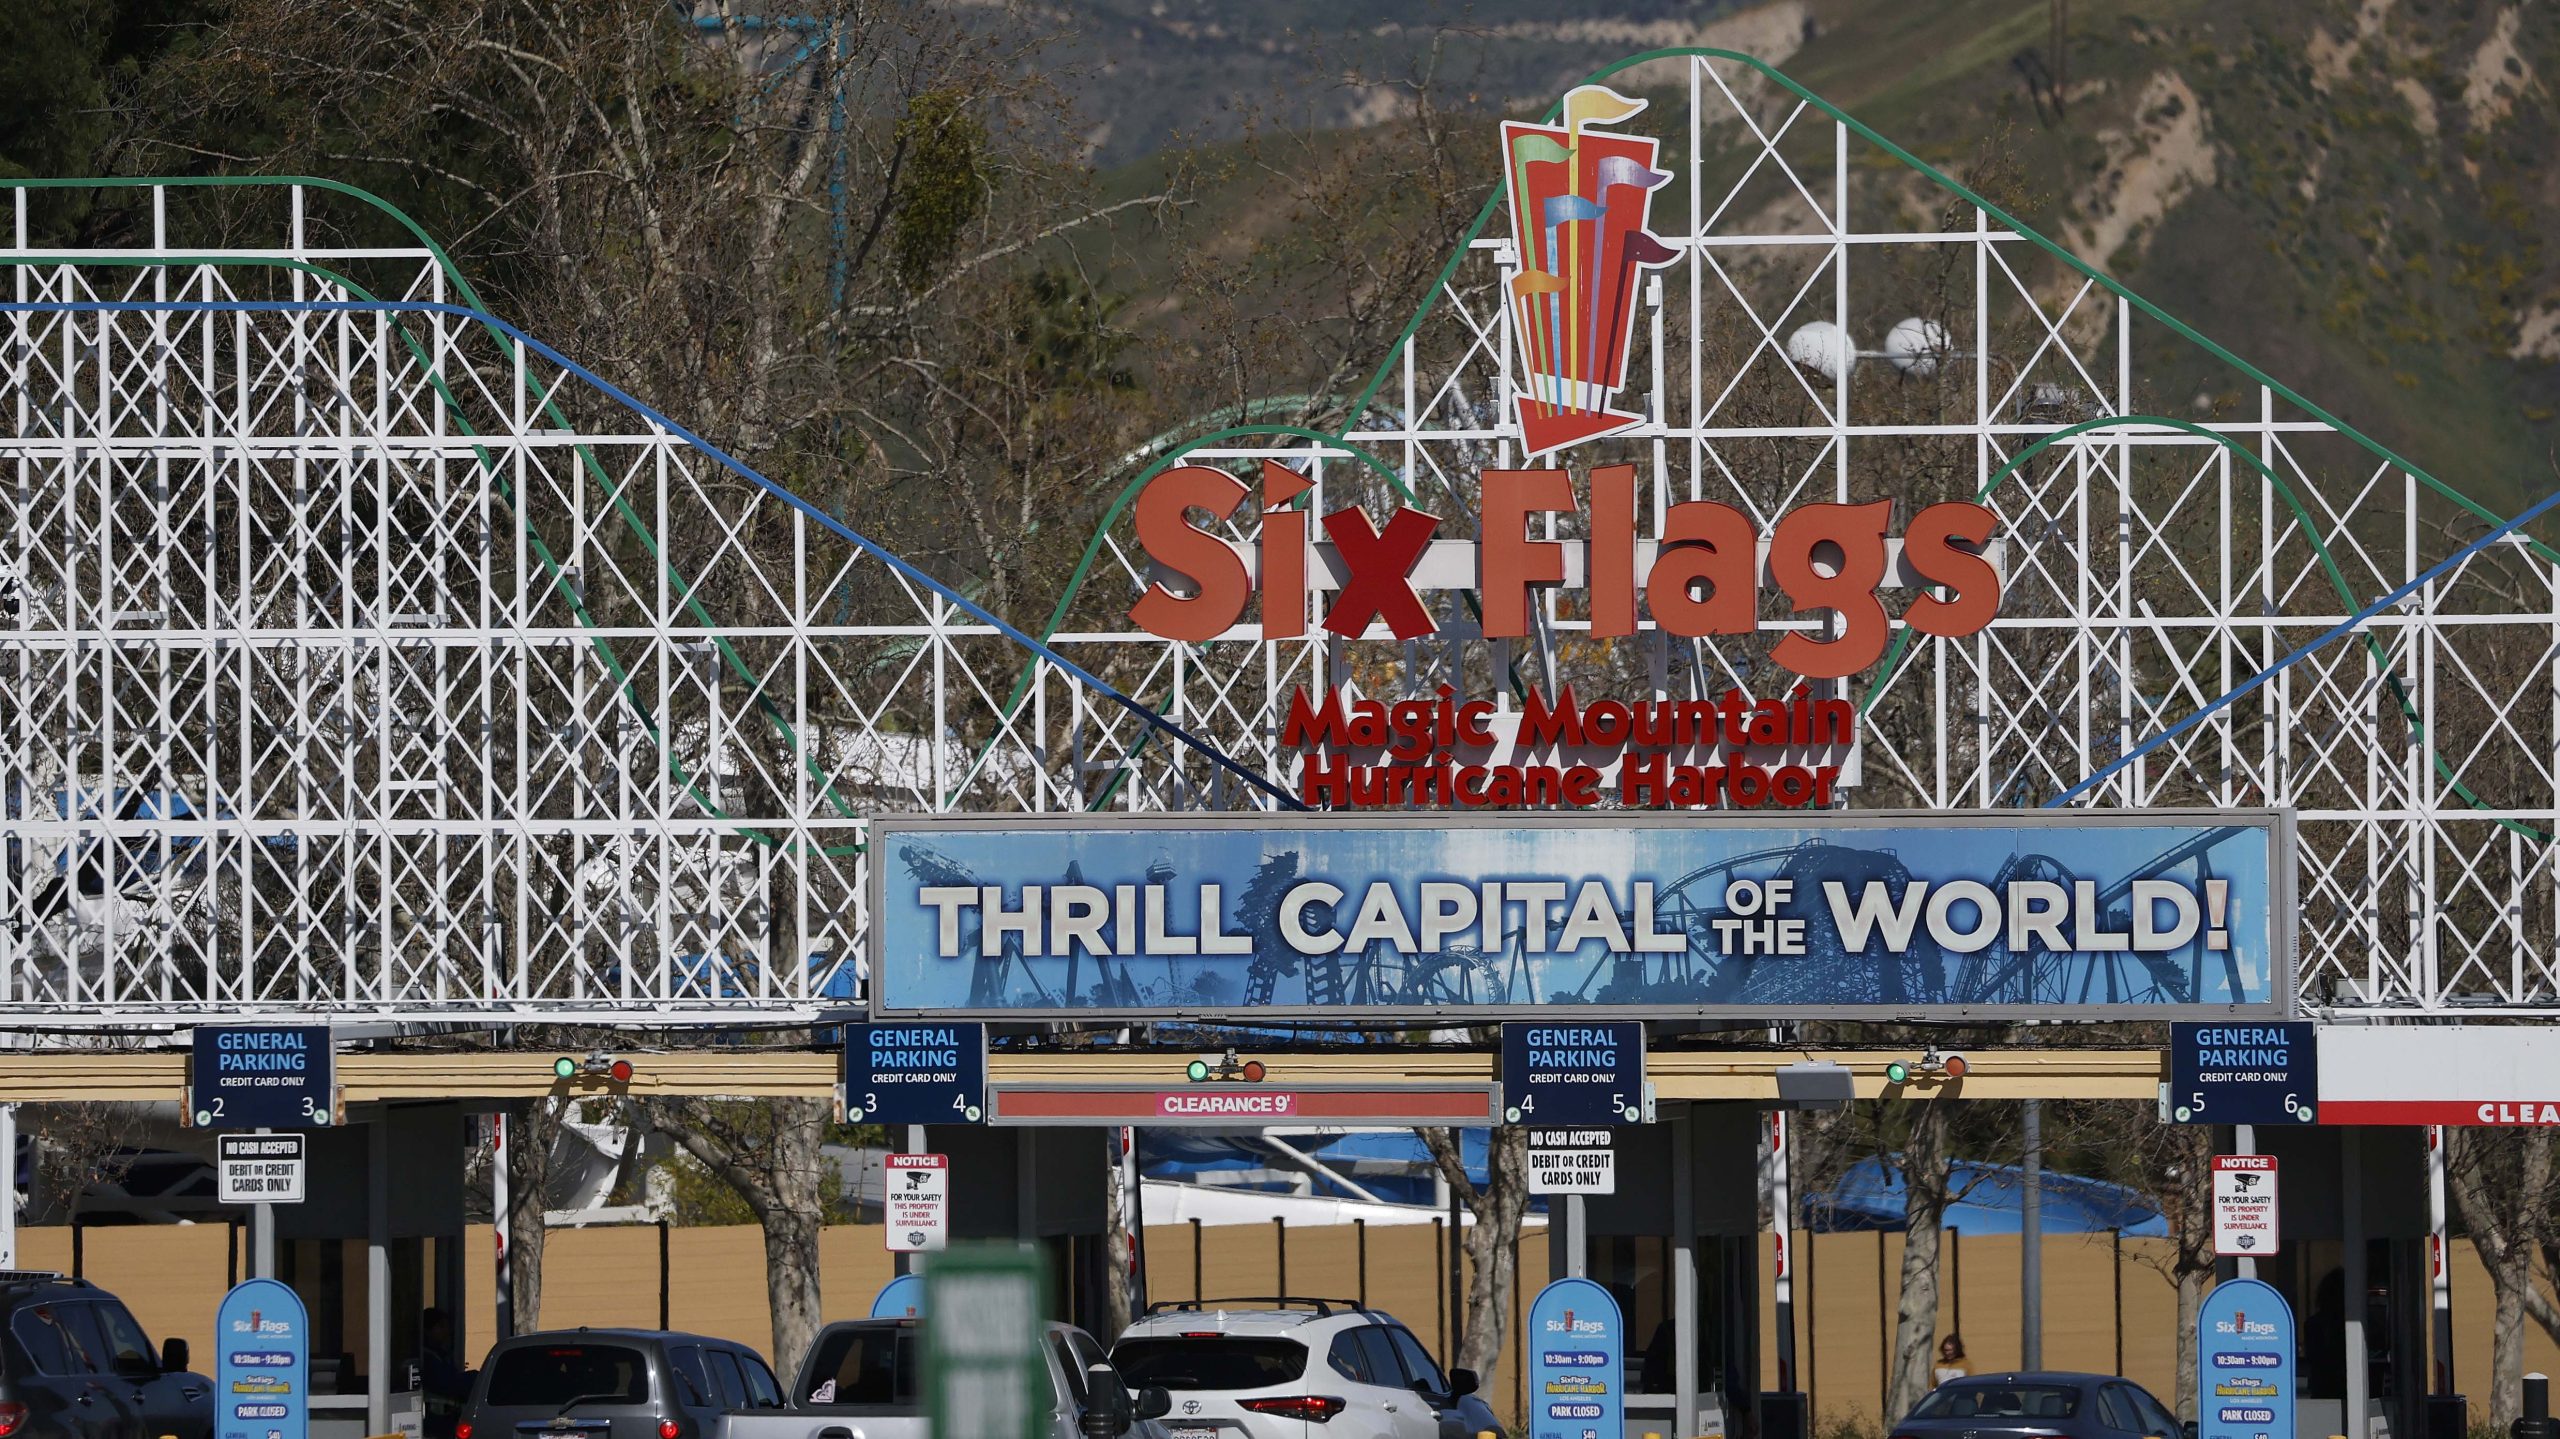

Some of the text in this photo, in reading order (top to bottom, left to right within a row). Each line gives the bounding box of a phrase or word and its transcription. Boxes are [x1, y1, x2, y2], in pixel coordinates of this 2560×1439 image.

[1126, 459, 2003, 678] Six Flags
[1282, 680, 1856, 761] Magic Mountain
[1300, 751, 1841, 809] Hurricane Harbor
[918, 879, 2229, 958] THRILL CAPITAL OF THE WORLD!
[218, 1033, 307, 1050] GENERAL
[869, 1029, 959, 1047] GENERAL
[1526, 1029, 1618, 1047] GENERAL
[2196, 1028, 2289, 1046] GENERAL
[219, 1053, 305, 1071] PARKING
[871, 1050, 957, 1067] PARKING
[1529, 1050, 1616, 1067] PARKING
[2199, 1049, 2288, 1066] PARKING
[220, 1077, 305, 1086] CREDIT CARD ONLY
[871, 1073, 957, 1083] CREDIT CARD ONLY
[1529, 1073, 1616, 1083] CREDIT CARD ONLY
[2199, 1072, 2288, 1082] CREDIT CARD ONLY
[212, 1097, 225, 1117] 2
[301, 1096, 314, 1117] 3
[864, 1093, 877, 1113] 3
[952, 1093, 966, 1113] 4
[1163, 1094, 1290, 1112] CLEARANCE 9'
[1520, 1094, 1535, 1114] 4
[1612, 1093, 1625, 1114] 5
[2192, 1092, 2206, 1112] 5
[2284, 1093, 2298, 1113] 6
[2477, 1103, 2560, 1123] CLEA
[1530, 1130, 1611, 1146] NO CASH ACCEPTED
[226, 1141, 298, 1155] NO CASH ACCEPTED
[229, 1163, 295, 1176] DEBIT OR CREDIT
[893, 1156, 939, 1166] NOTICE
[1531, 1154, 1610, 1168] DEBIT OR CREDIT
[2221, 1158, 2268, 1168] NOTICE
[232, 1178, 292, 1192] CARDS ONLY
[1541, 1171, 1601, 1185] CARDS ONLY
[2231, 1196, 2249, 1204] YOUR
[233, 1320, 290, 1333] Six Flags
[1546, 1320, 1603, 1333] Six Flags
[2216, 1321, 2275, 1334] Six Flags
[1545, 1354, 1572, 1364] 10:30am
[1578, 1355, 1604, 1366] 9:00pm
[2217, 1356, 2245, 1365] 10:30am
[2251, 1356, 2277, 1366] 9:00pm
[238, 1406, 286, 1417] PARK CLOSED
[1551, 1406, 1600, 1417] PARK CLOSED
[2222, 1410, 2271, 1421] PARK CLOSED
